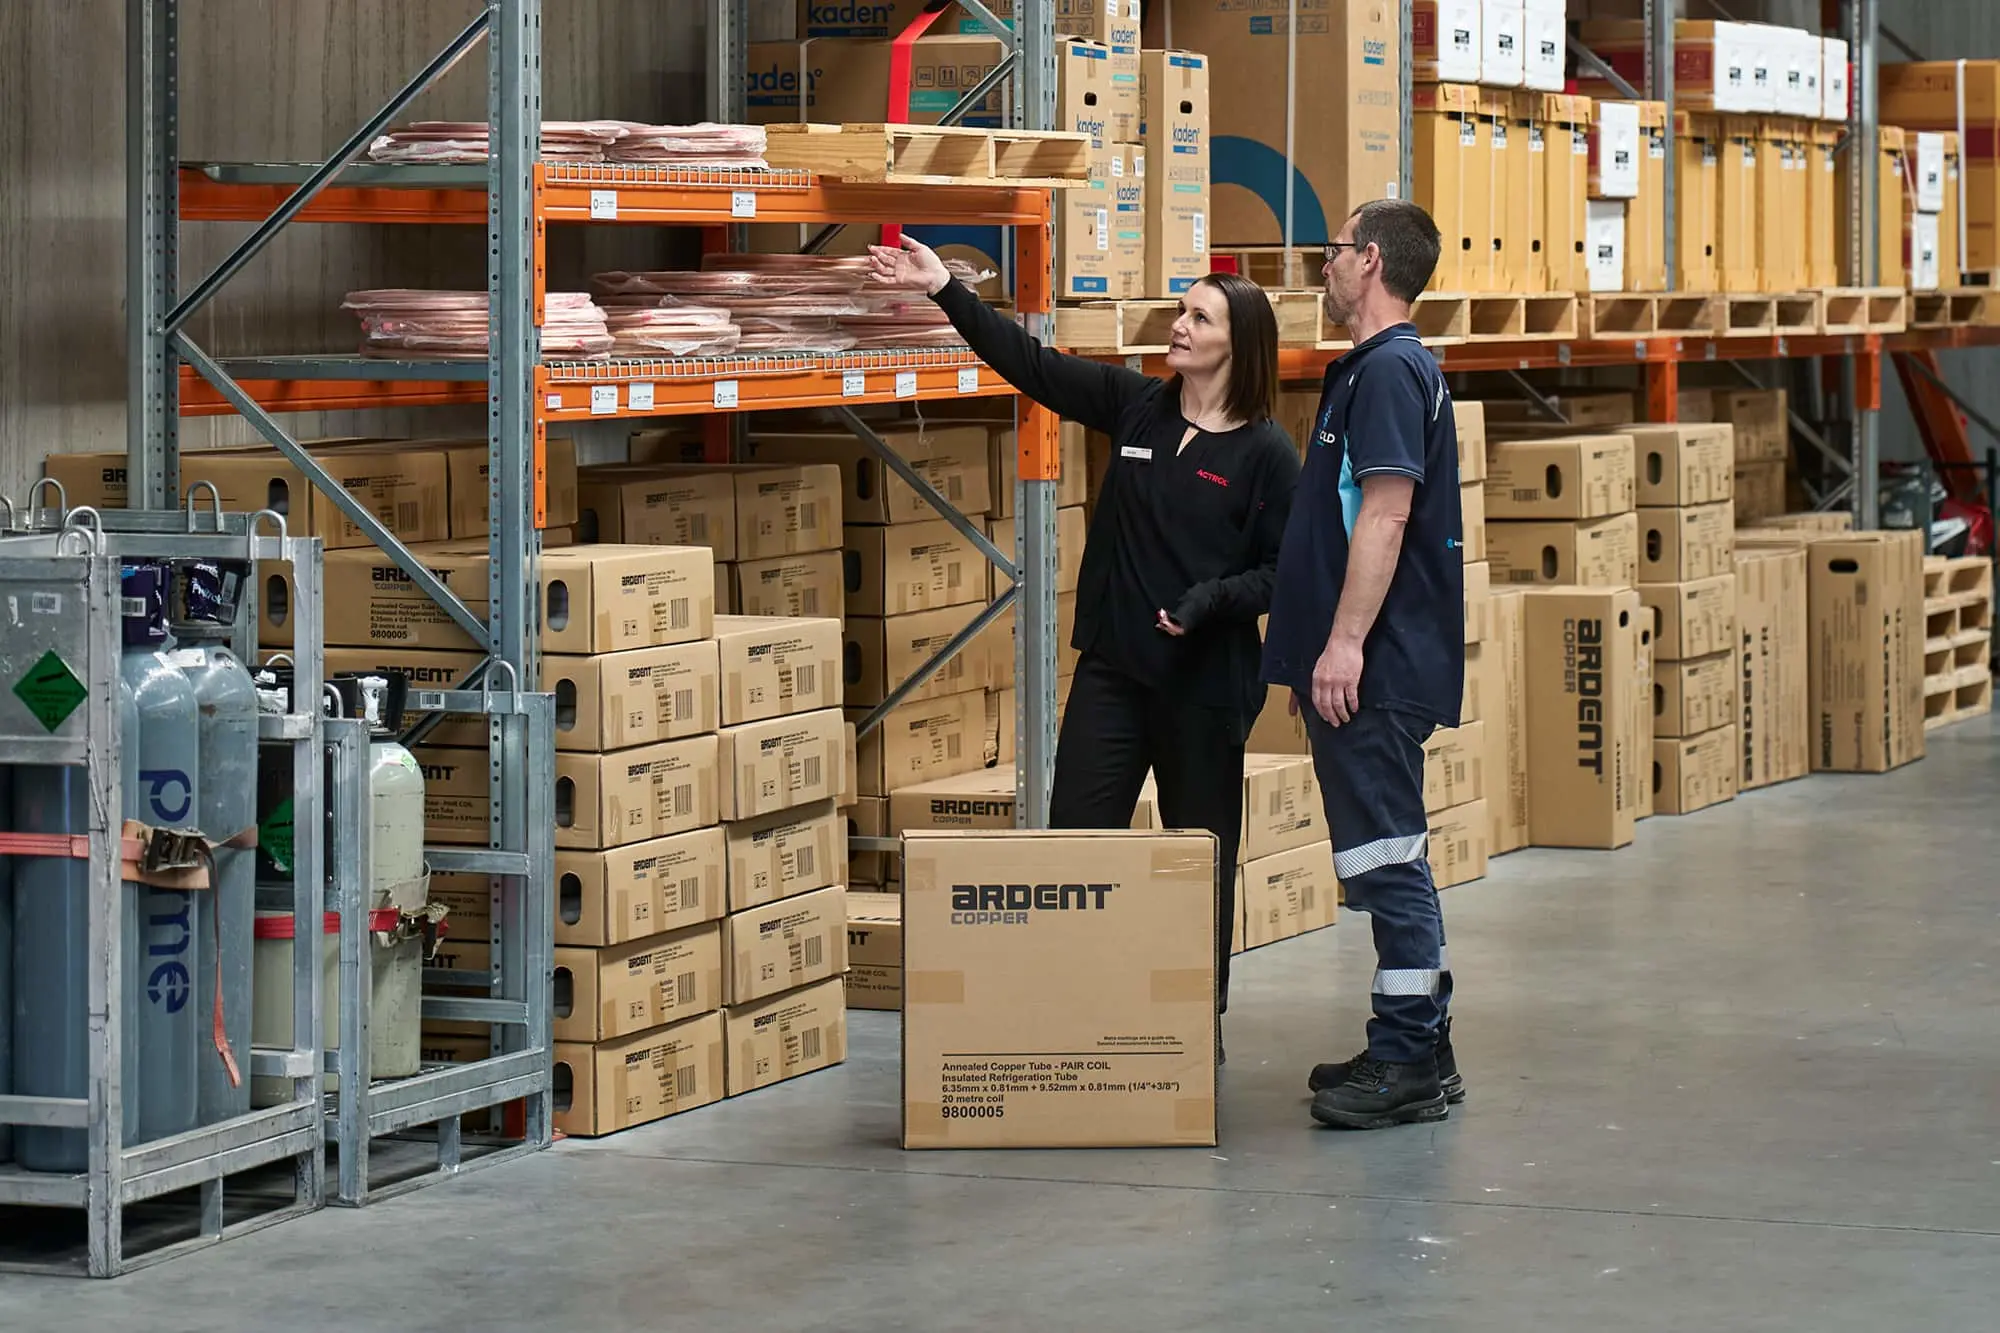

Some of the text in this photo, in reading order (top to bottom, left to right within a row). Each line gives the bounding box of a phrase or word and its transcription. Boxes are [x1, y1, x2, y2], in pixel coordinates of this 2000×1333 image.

[1564, 619, 1576, 693] COPPER
[931, 800, 1013, 816] ARDENT
[951, 912, 1029, 925] COPPER
[942, 1062, 989, 1072] Annealed
[990, 1062, 1026, 1073] Copper
[1028, 1062, 1052, 1071] Tube
[1060, 1061, 1084, 1071] PAIR
[1086, 1061, 1111, 1071] COIL
[942, 1072, 1078, 1084] Insulated Refrigeration Tube
[942, 1083, 980, 1093] 6.35mm
[1039, 1083, 1078, 1092] 9.52mm
[942, 1094, 1004, 1103] 20 metre coil
[942, 1106, 1004, 1118] 9800005
